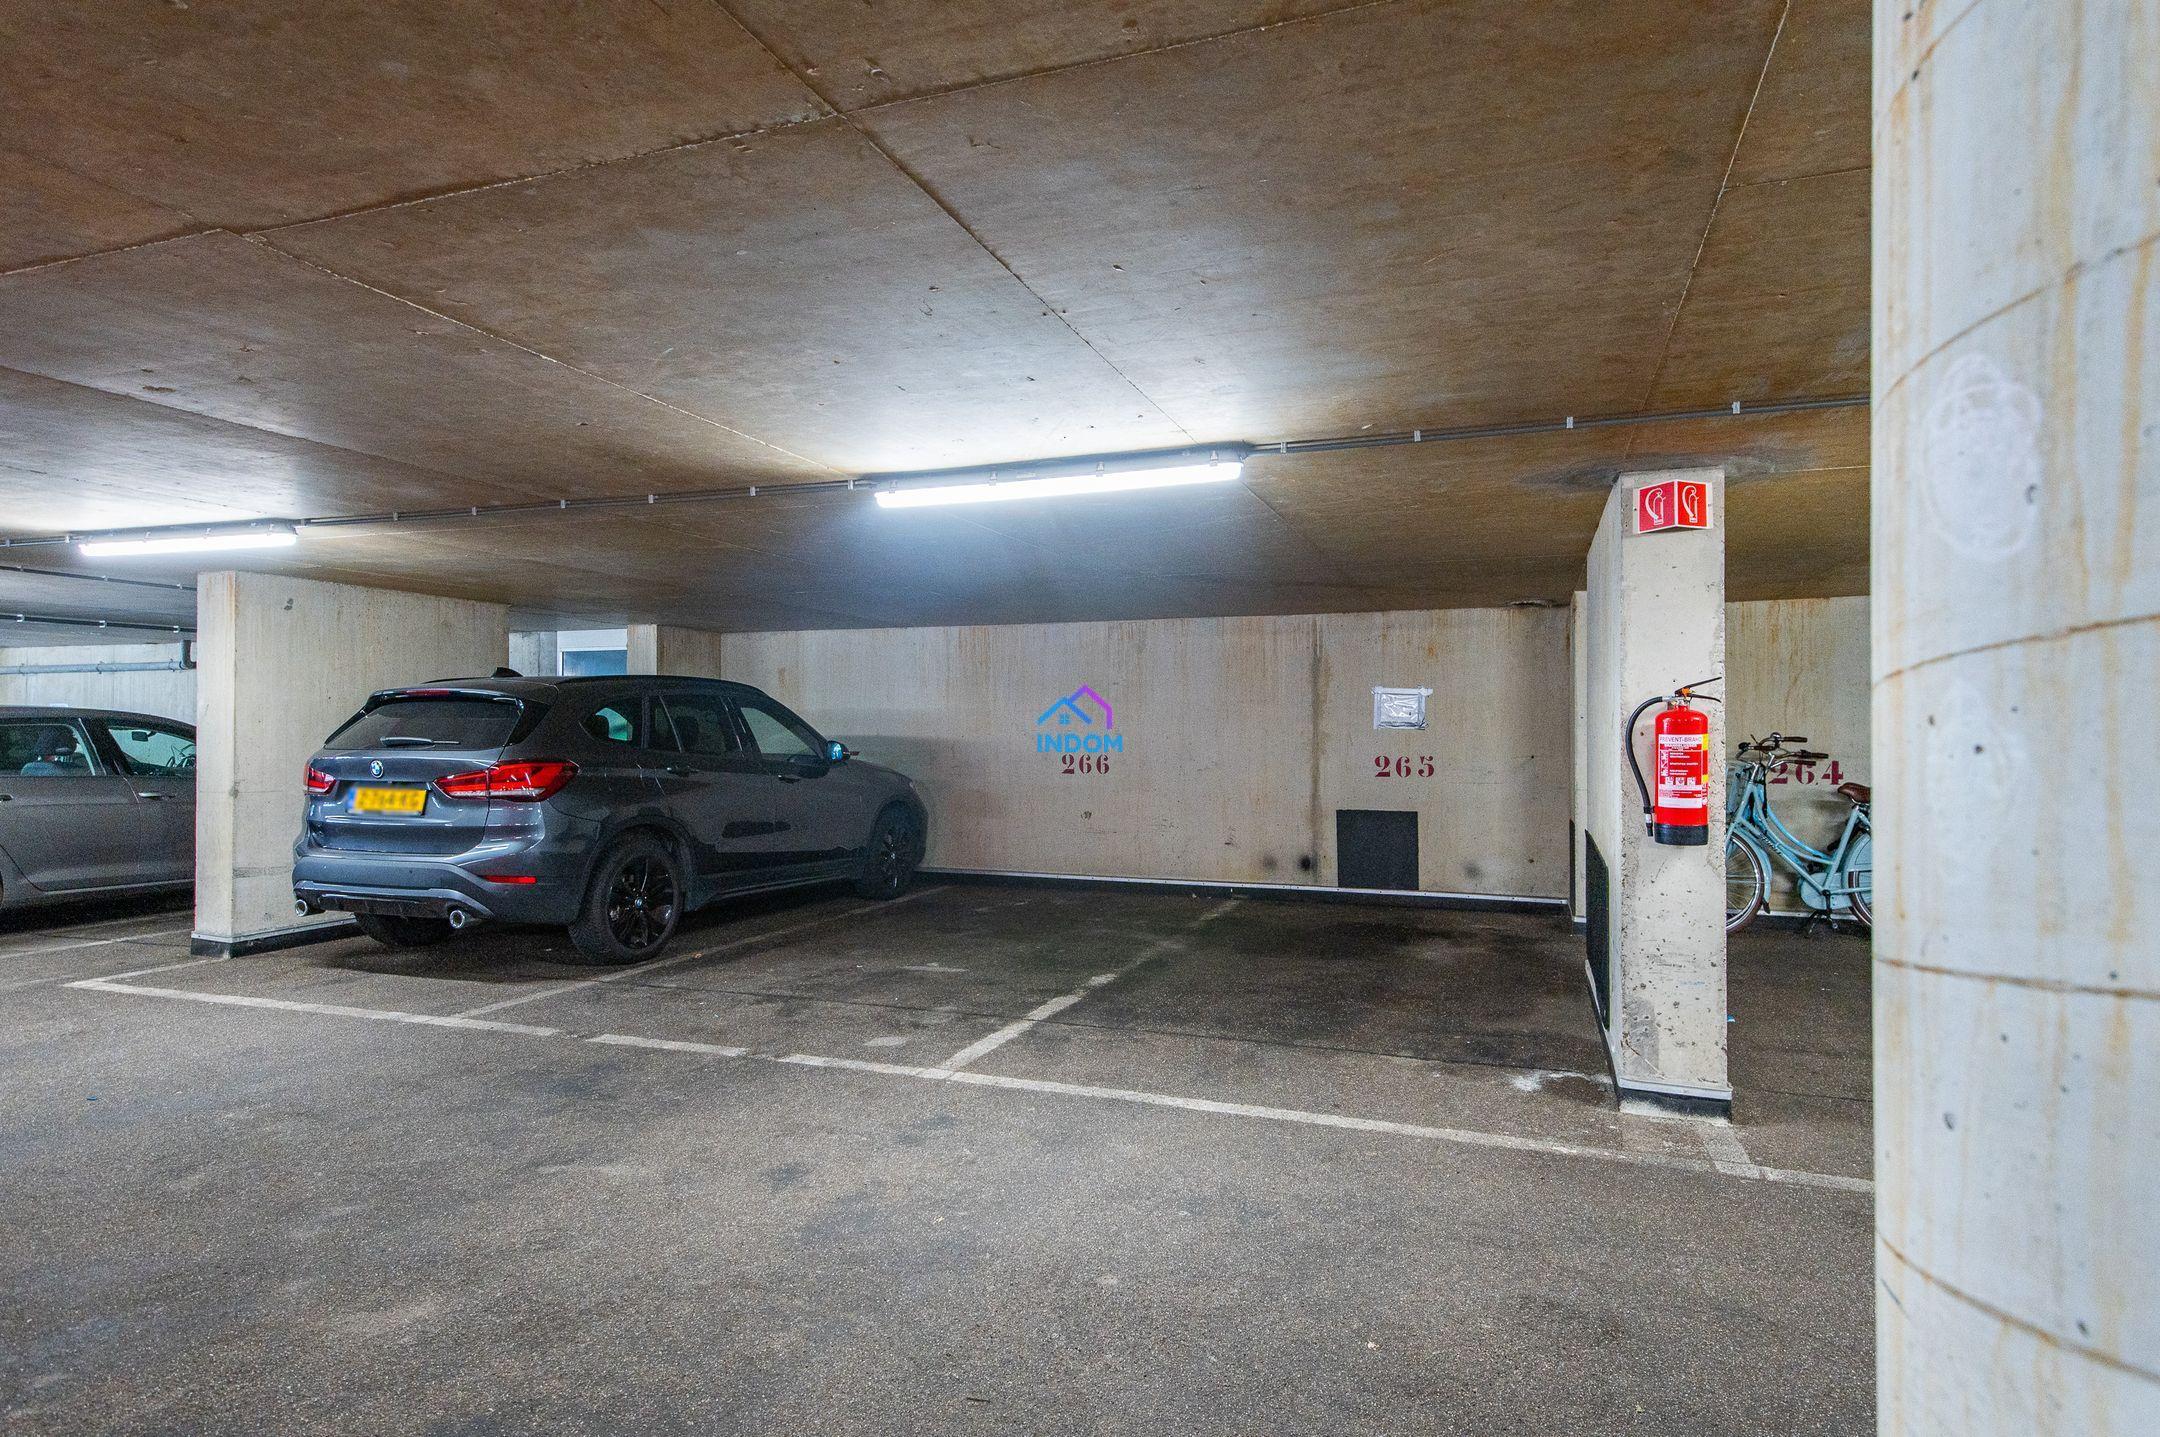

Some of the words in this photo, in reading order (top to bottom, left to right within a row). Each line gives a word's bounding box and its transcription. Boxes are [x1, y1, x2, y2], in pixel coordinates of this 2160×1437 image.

[1061, 753, 1110, 774] 266
[1374, 755, 1435, 778] 265
[1768, 760, 1844, 785] 264
